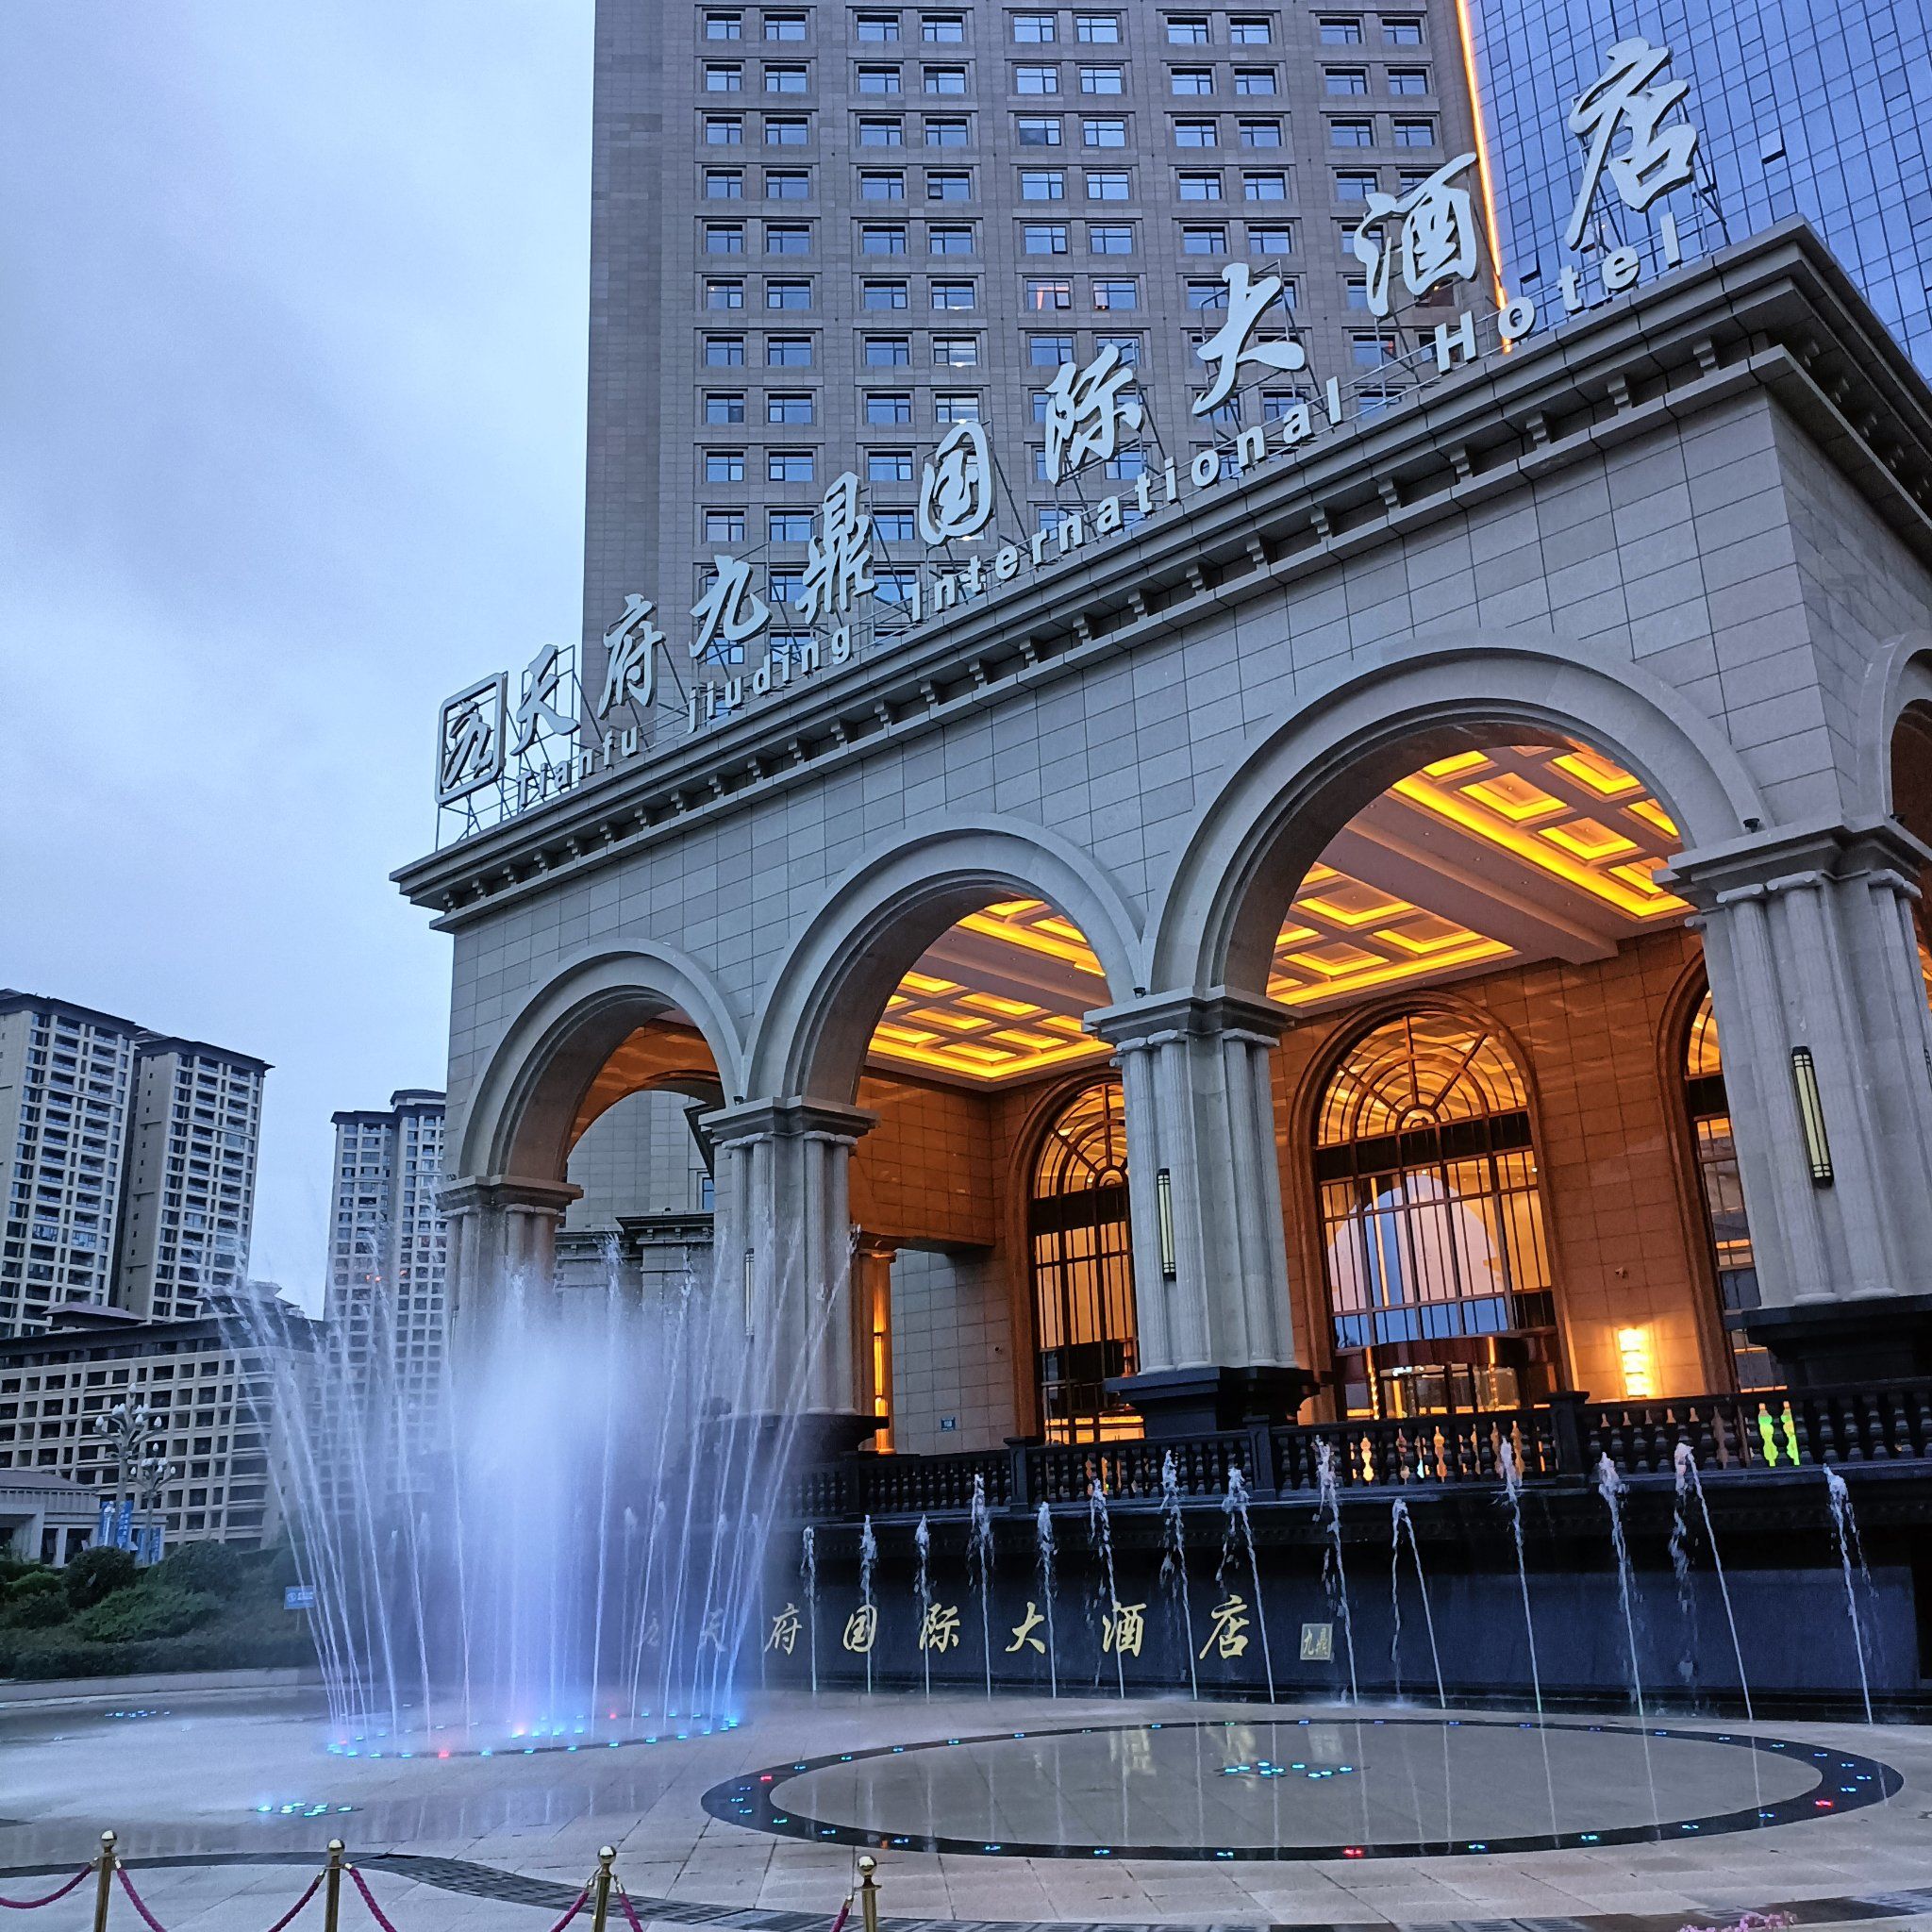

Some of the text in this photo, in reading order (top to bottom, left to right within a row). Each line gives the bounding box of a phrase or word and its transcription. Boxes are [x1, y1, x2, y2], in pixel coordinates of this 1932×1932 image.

[510, 36, 1699, 757] 天府九鼎国际大酒店
[516, 726, 640, 807] Tianfu
[911, 375, 1344, 623] International
[1435, 212, 1684, 375] Hotel
